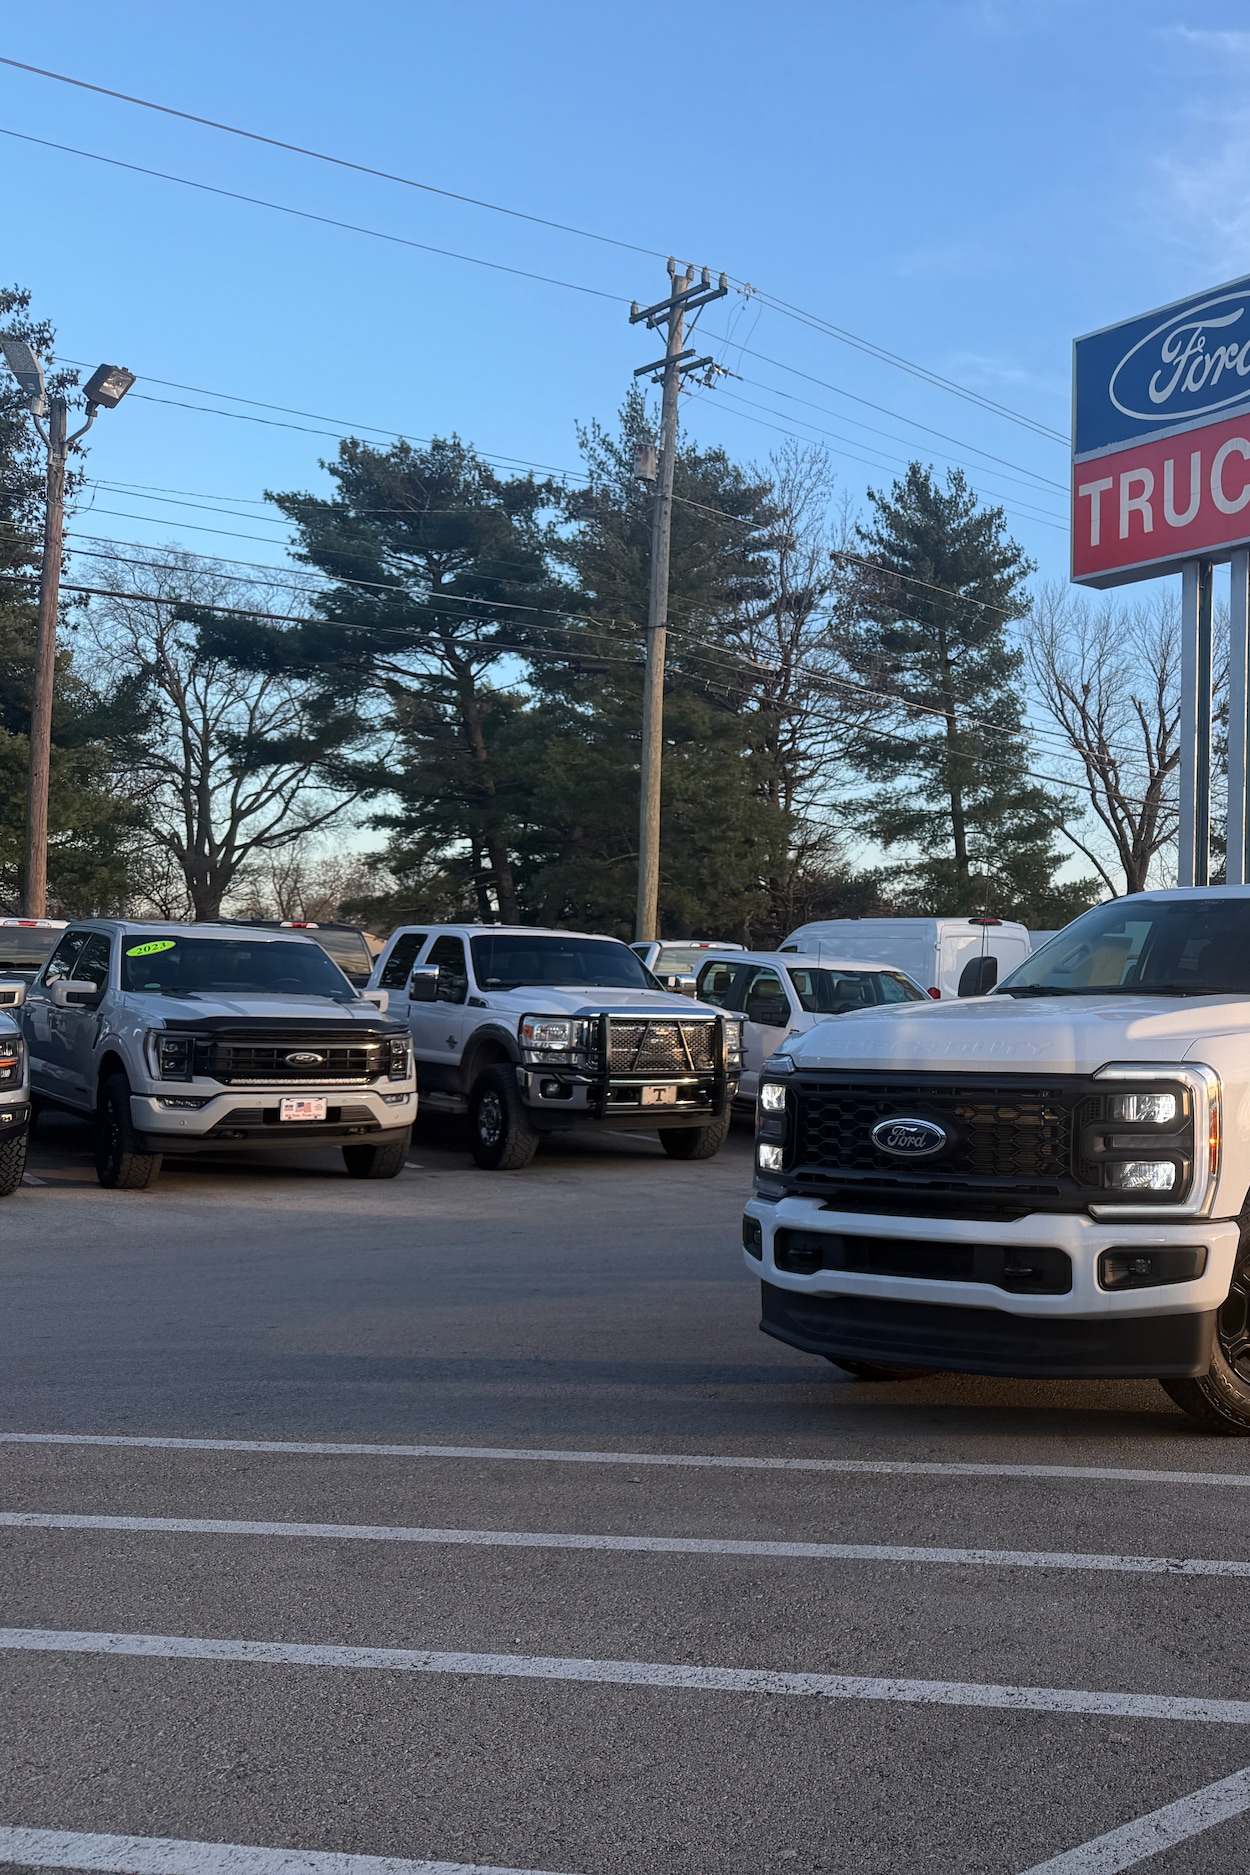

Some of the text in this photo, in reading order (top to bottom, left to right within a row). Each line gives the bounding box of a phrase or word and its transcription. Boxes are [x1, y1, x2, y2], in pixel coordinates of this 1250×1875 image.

[136, 942, 167, 954] 2023
[653, 1088, 667, 1102] T
[887, 1126, 927, 1148] Ford
